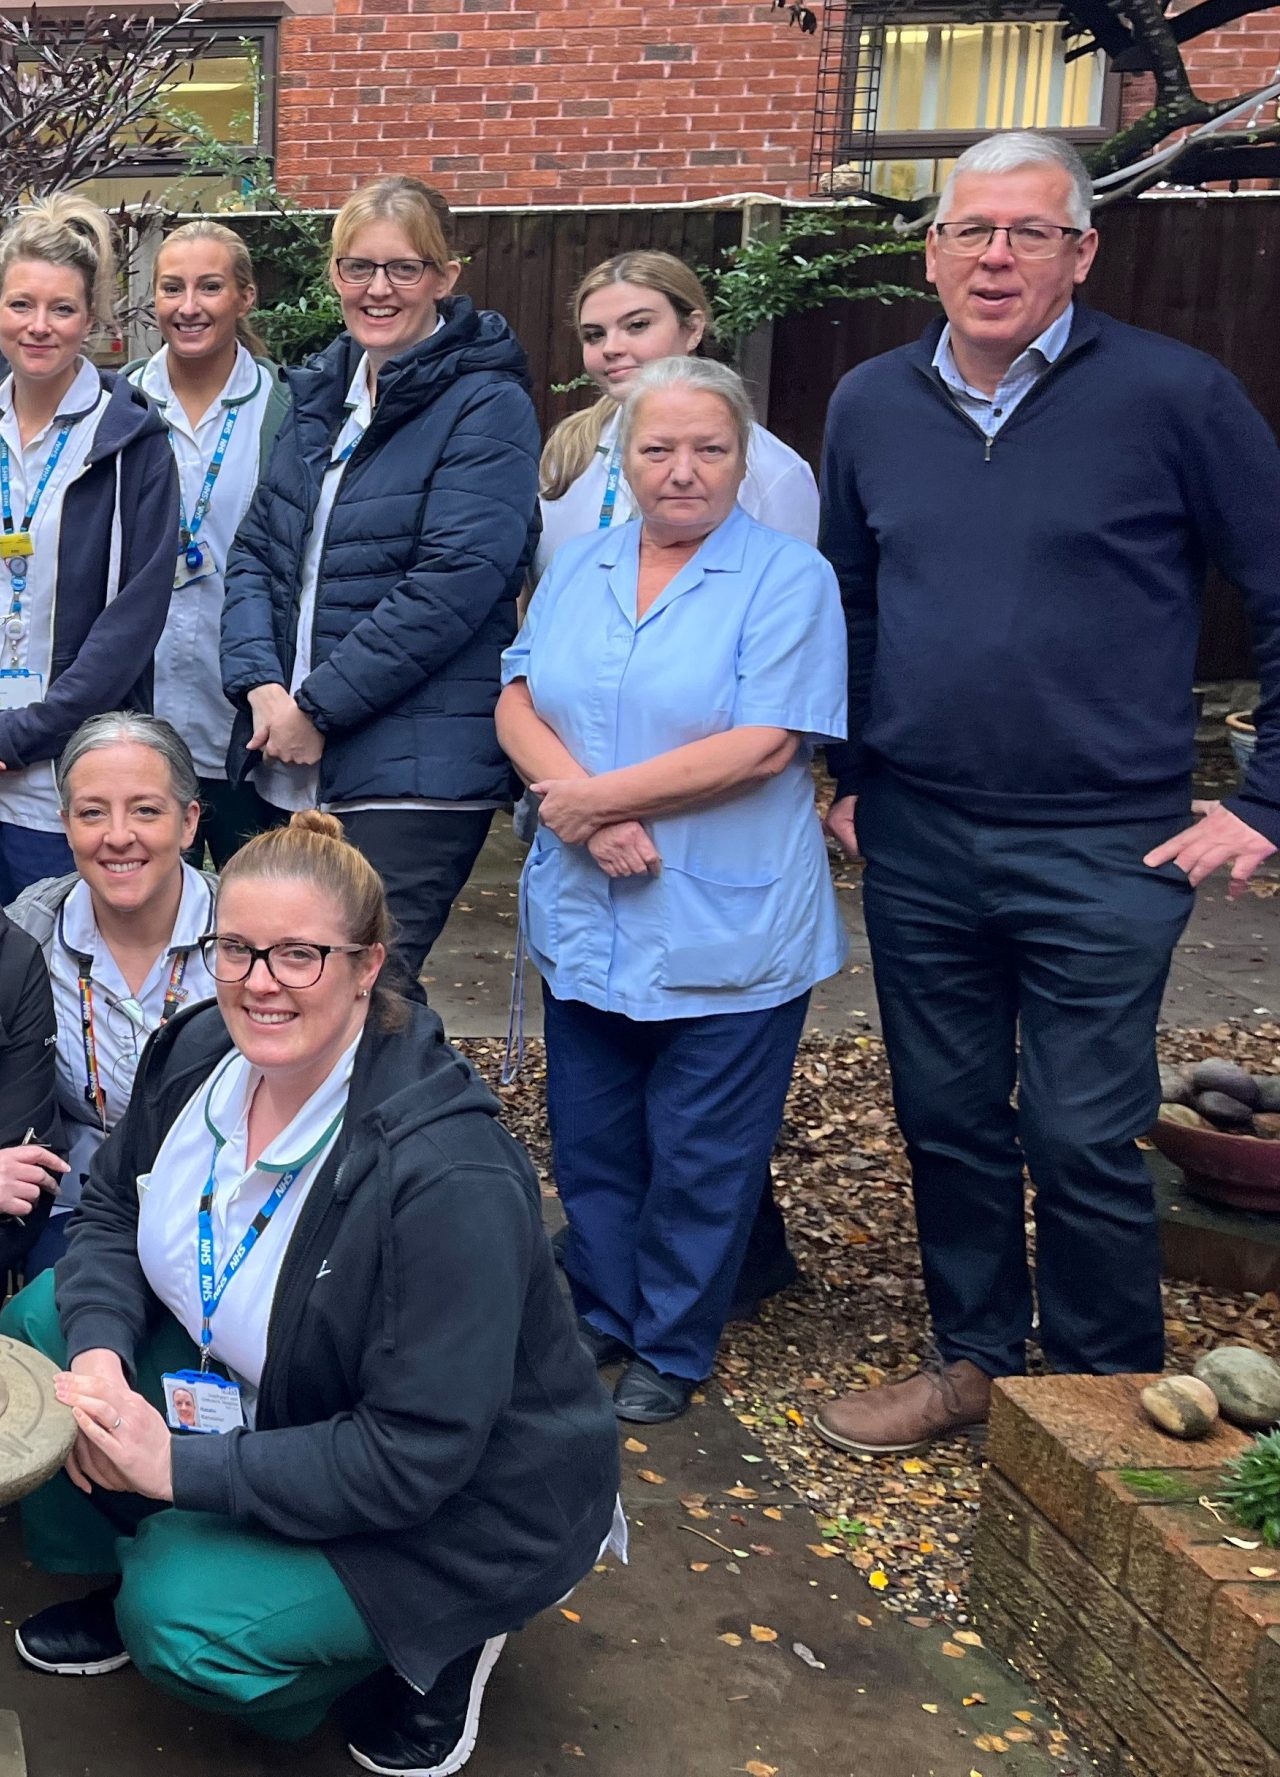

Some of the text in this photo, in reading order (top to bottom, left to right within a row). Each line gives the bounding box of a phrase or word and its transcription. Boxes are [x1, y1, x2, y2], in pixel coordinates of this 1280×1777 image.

[224, 418, 234, 435] NHS
[51, 441, 62, 458] NHS
[218, 439, 228, 455] NHS
[201, 482, 211, 499] NHS
[275, 1173, 294, 1198] NHS
[201, 1239, 213, 1302] NHS NHS
[213, 1244, 246, 1300] NHS NHS
